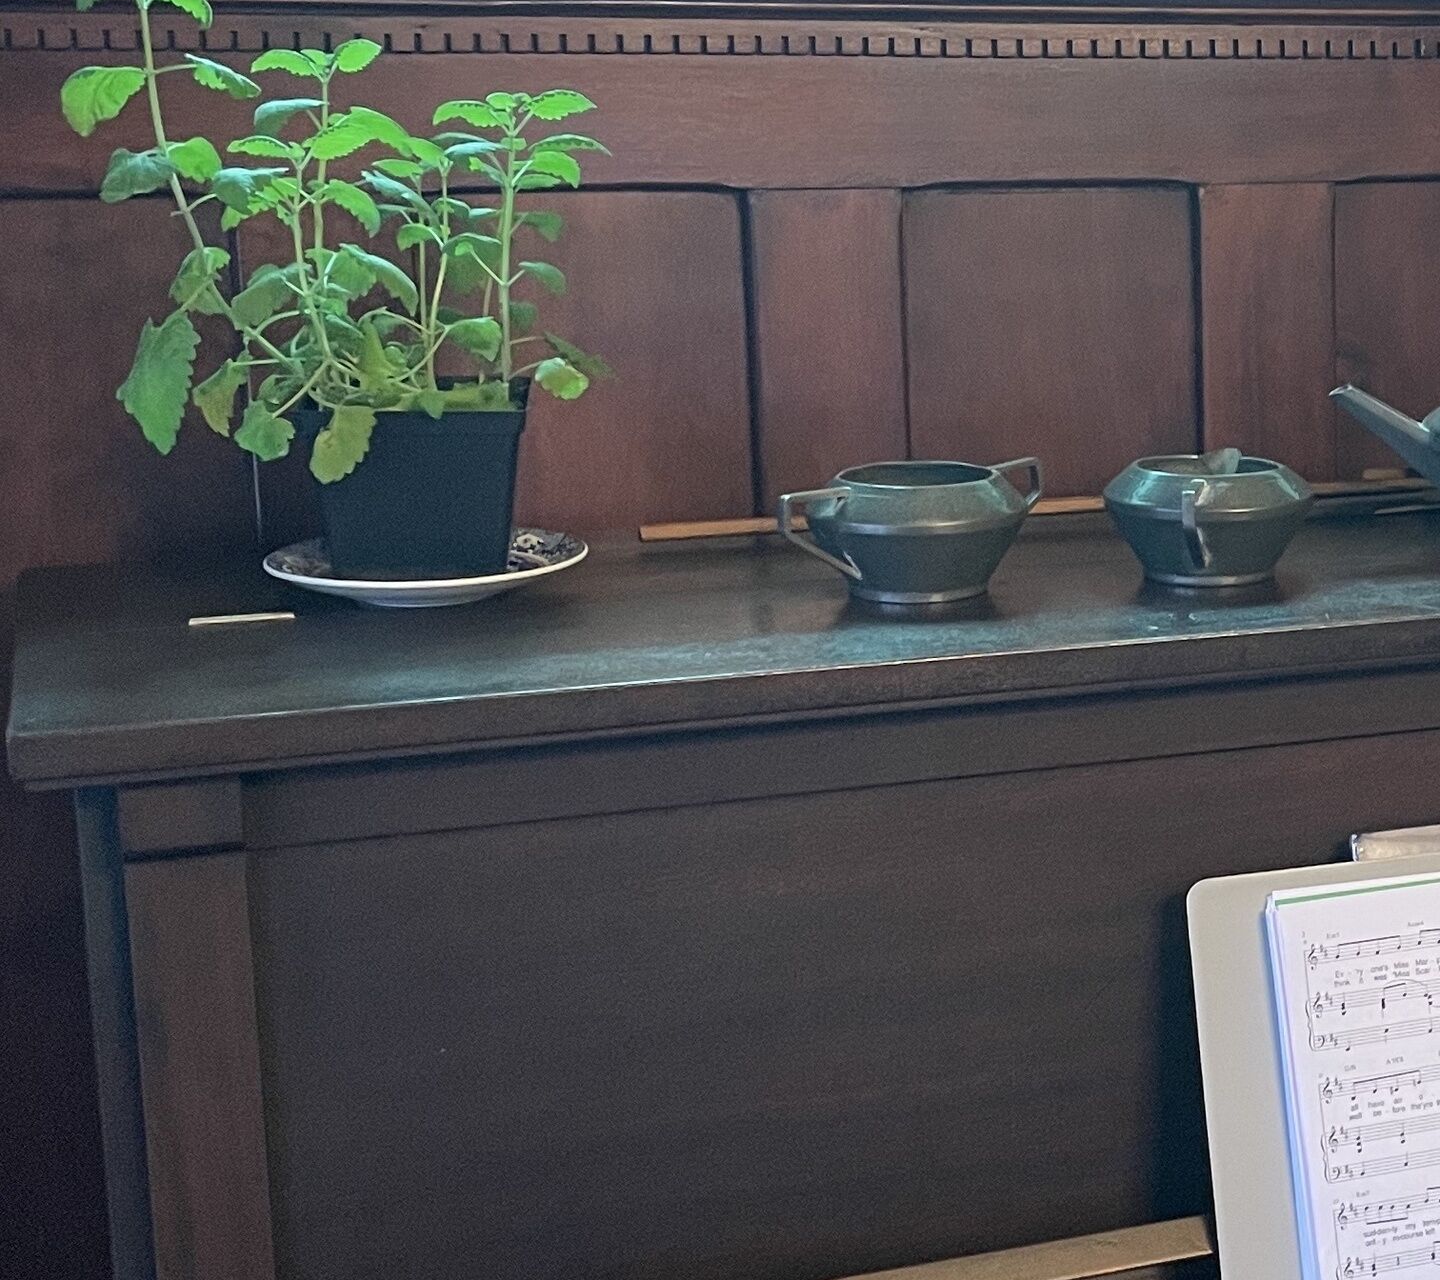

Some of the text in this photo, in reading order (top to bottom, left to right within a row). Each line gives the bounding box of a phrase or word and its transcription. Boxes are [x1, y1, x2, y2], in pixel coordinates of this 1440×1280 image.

[1370, 964, 1388, 972] one's
[1367, 1100, 1384, 1108] have
[1348, 1111, 1361, 1120] well
